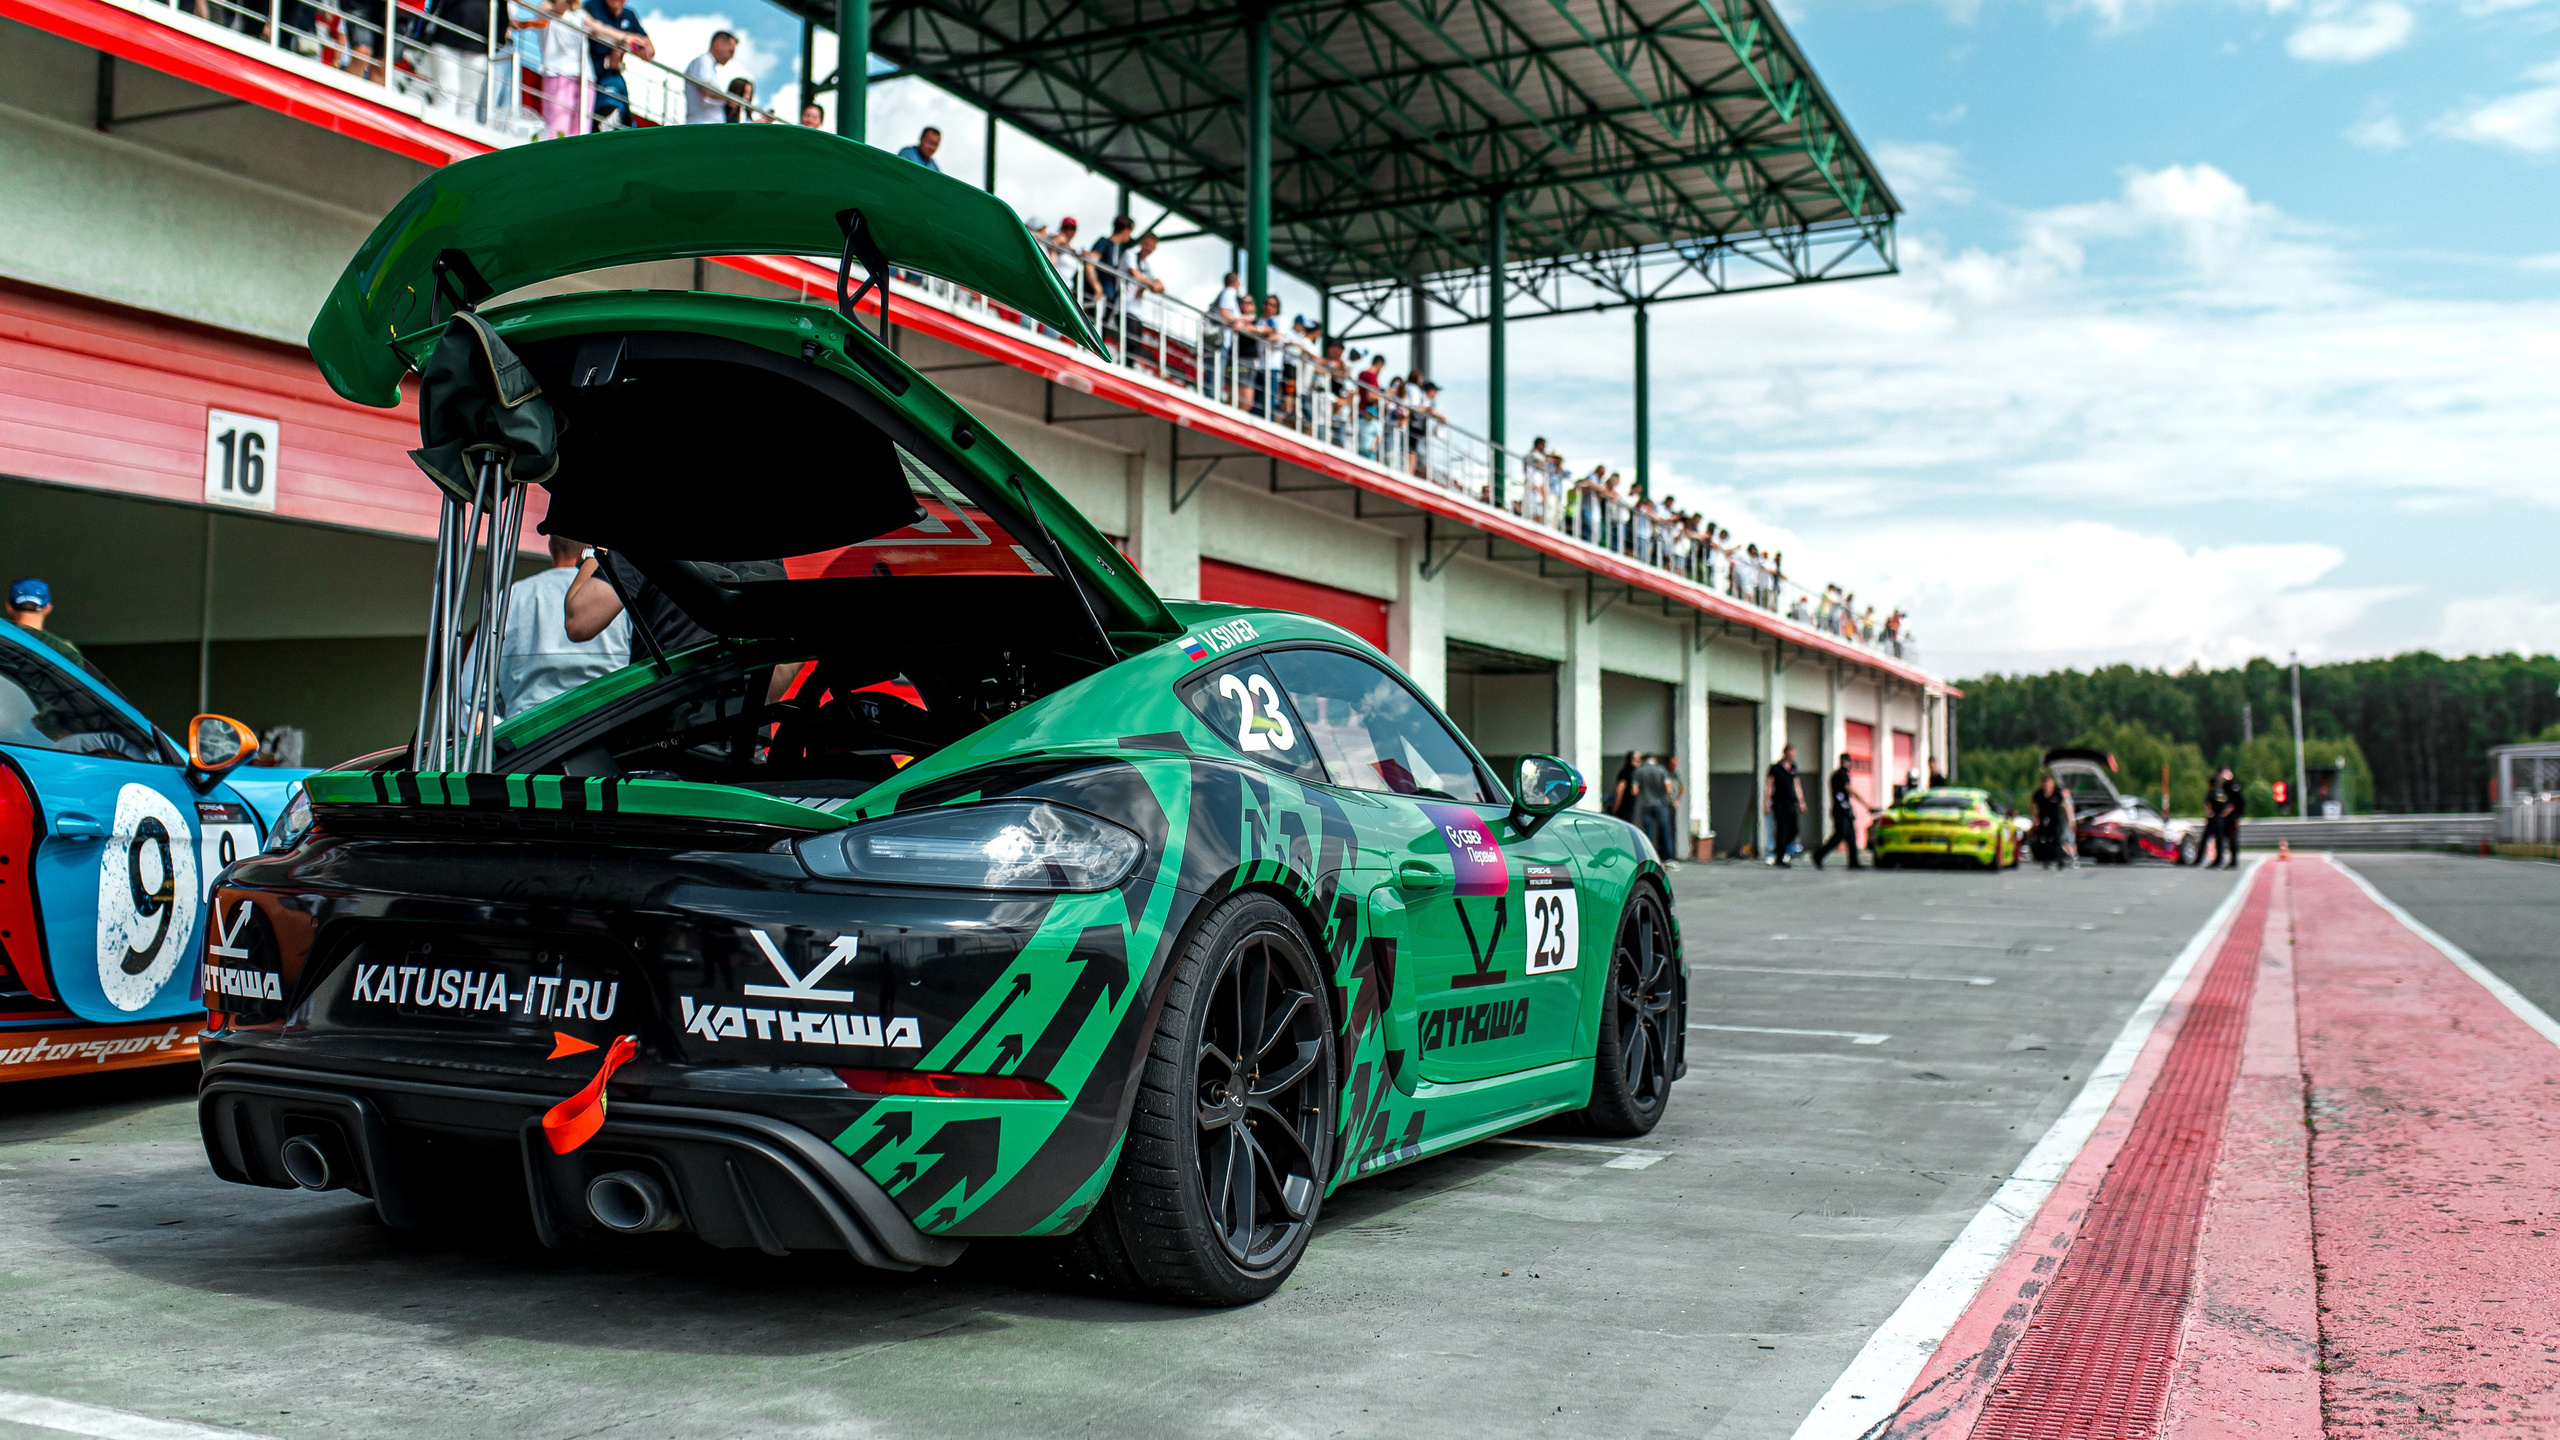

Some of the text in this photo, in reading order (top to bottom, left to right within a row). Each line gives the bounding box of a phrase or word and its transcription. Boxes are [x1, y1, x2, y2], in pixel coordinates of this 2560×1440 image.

[217, 428, 265, 495] 16
[1198, 618, 1260, 653] V.SIVER
[1219, 673, 1295, 751] 23
[1466, 846, 1499, 867] Первый
[120, 816, 175, 976] 9
[1534, 895, 1565, 968] 23
[352, 963, 619, 1021] KATUSHA-IT.RU
